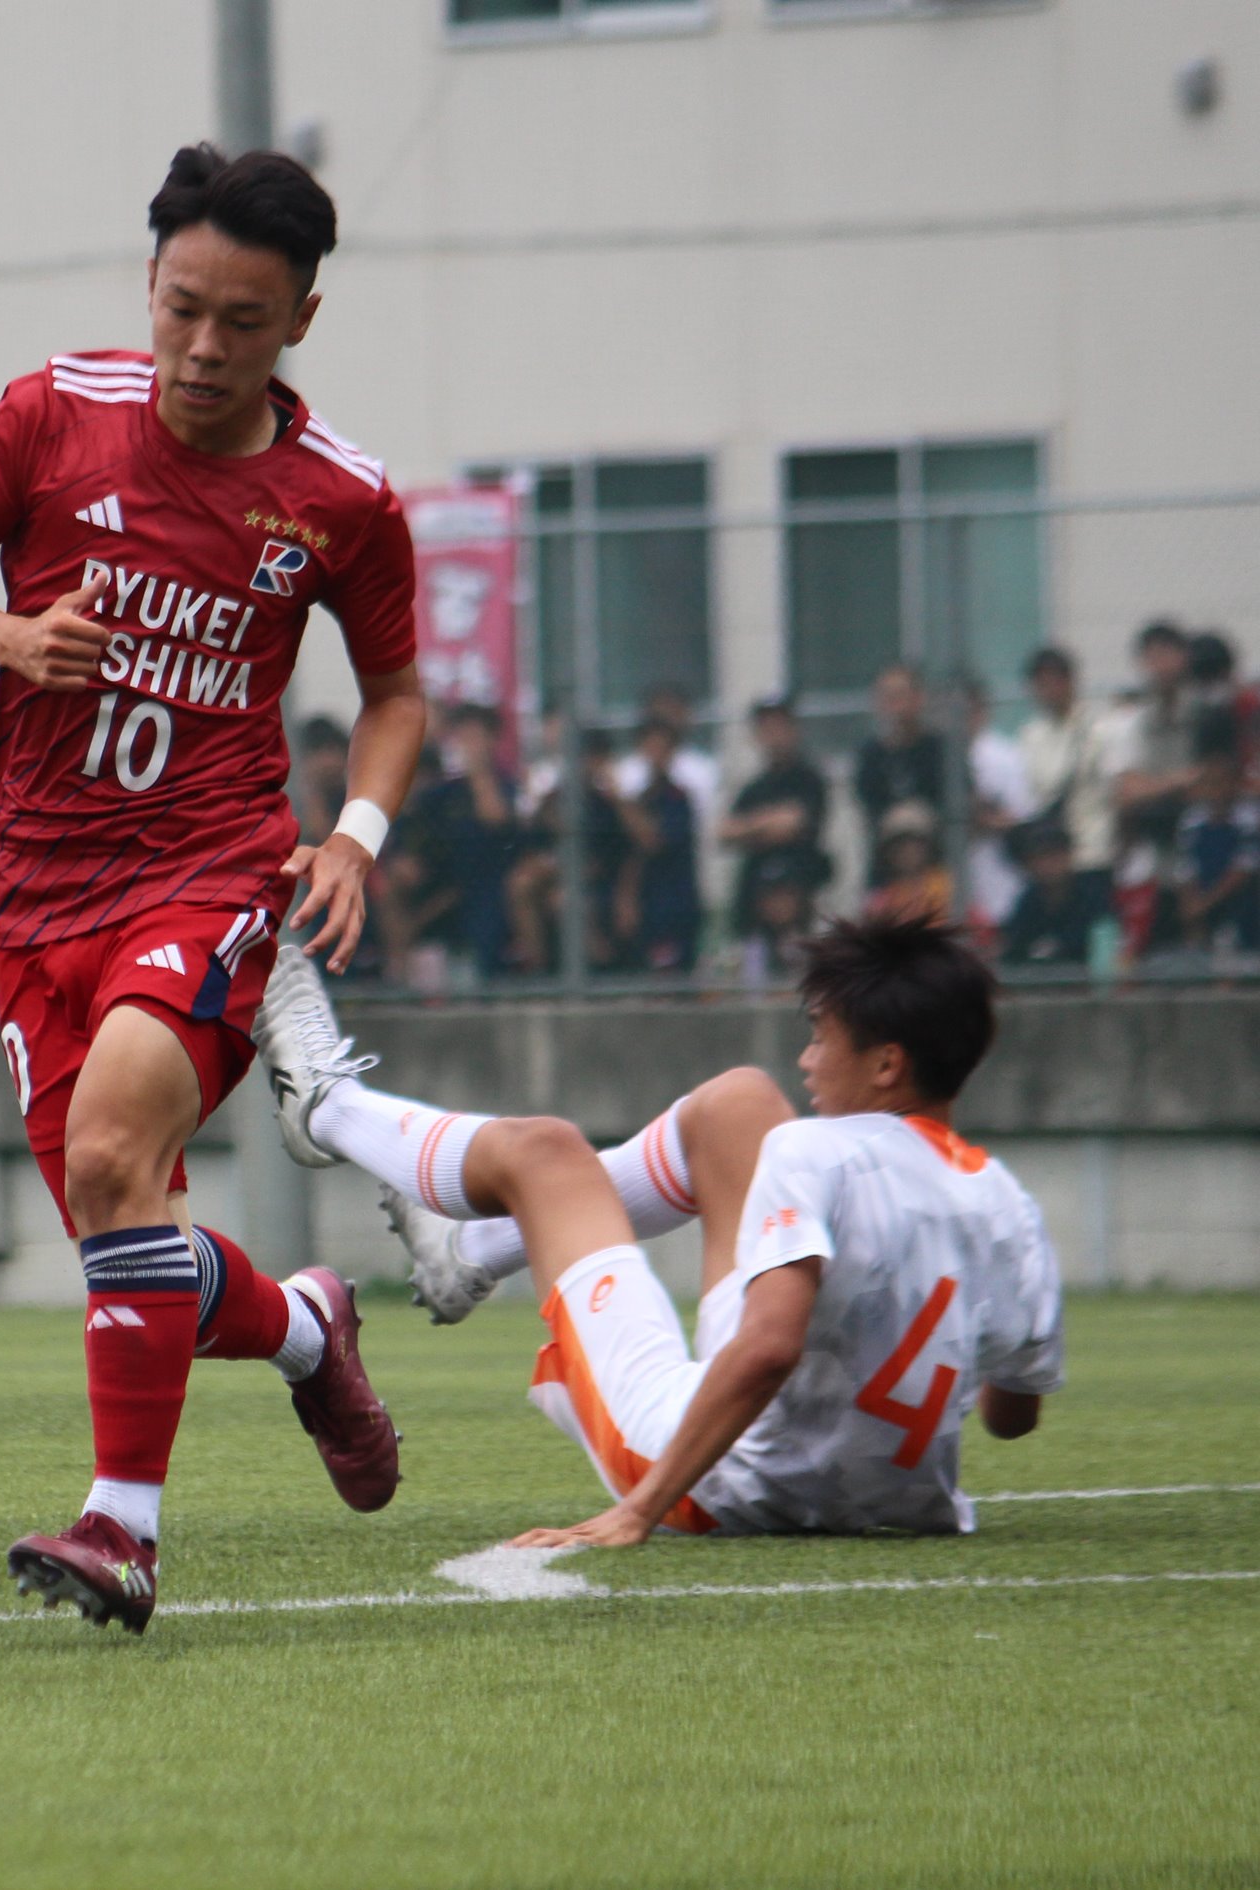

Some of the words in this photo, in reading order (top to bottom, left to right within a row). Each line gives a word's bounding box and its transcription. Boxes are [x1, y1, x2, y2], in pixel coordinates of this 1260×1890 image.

[81, 558, 256, 653] RYUKEI
[100, 631, 252, 710] SHIWA
[81, 691, 175, 792] 10
[854, 1276, 958, 1470] 4
